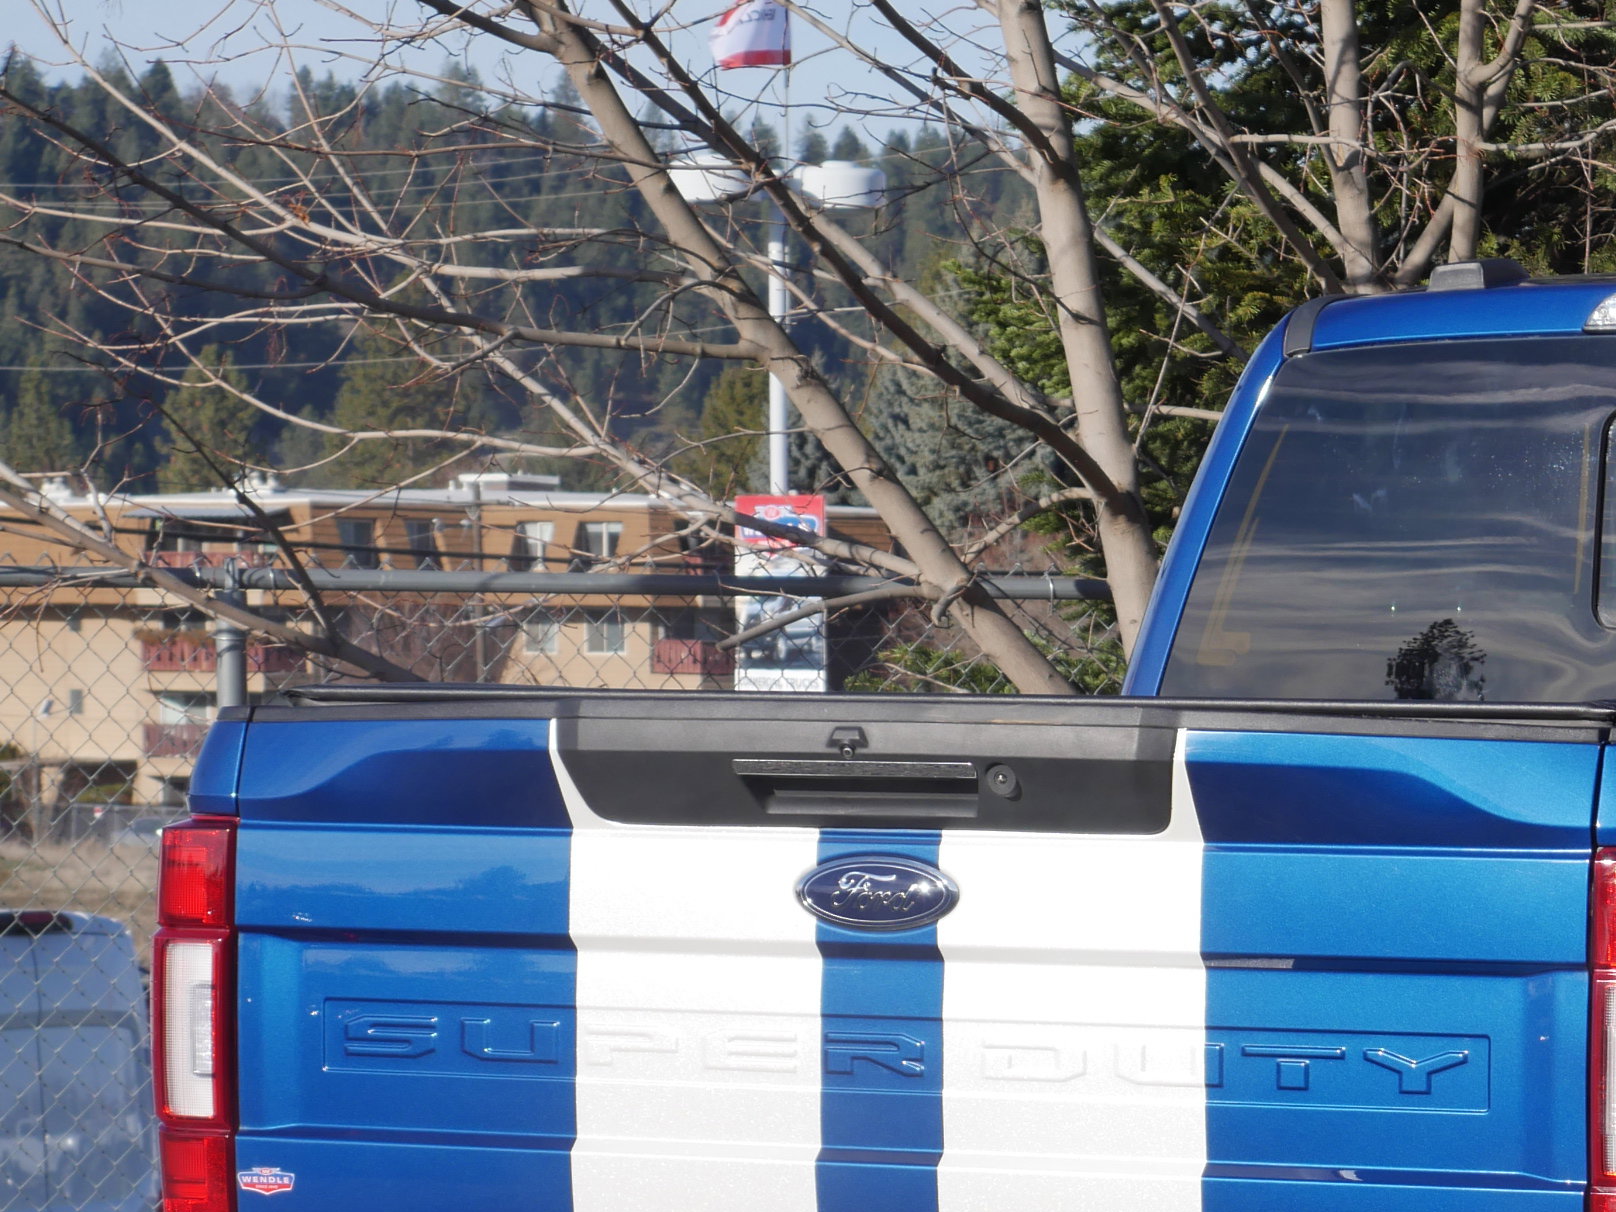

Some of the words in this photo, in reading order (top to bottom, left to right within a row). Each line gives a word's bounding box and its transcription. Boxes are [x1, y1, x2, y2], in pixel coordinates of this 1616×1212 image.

[831, 871, 918, 911] Ford
[344, 1016, 925, 1077] SUPER
[983, 1043, 1468, 1095] DUTY
[242, 1176, 290, 1184] WENDLE
